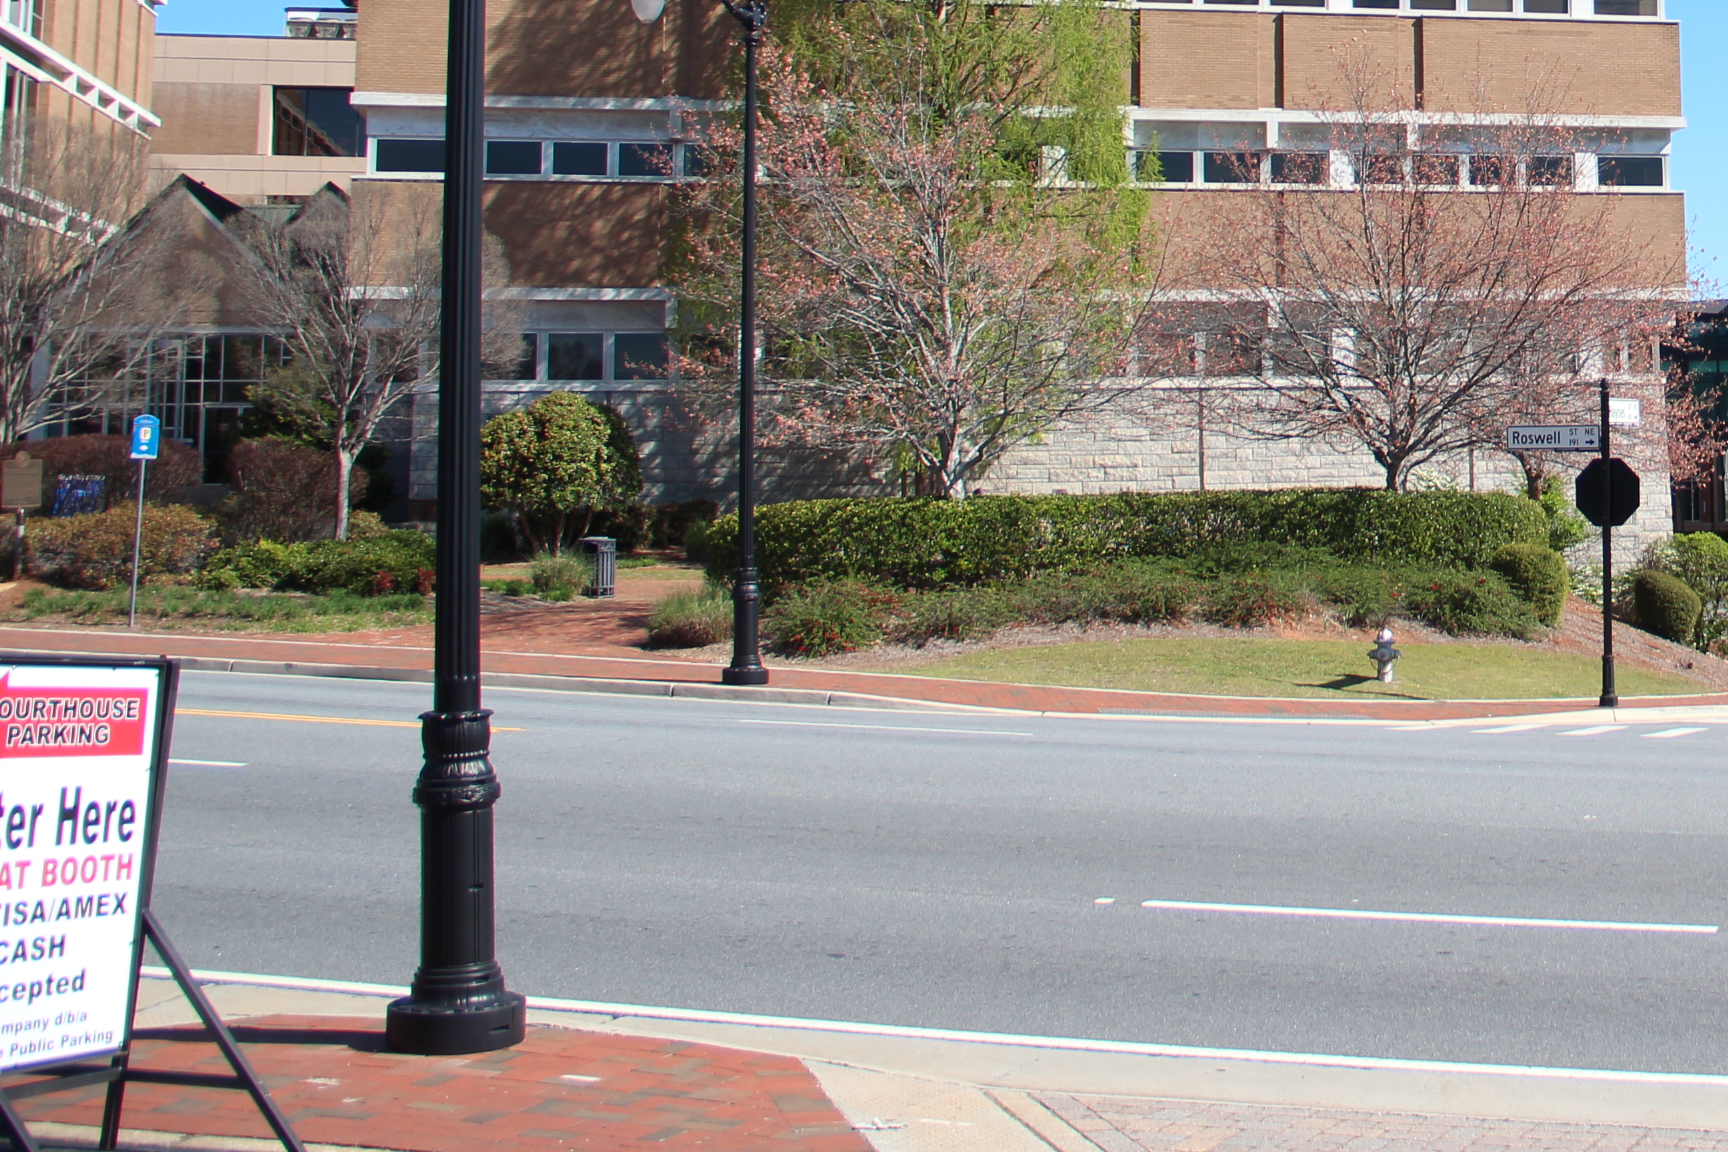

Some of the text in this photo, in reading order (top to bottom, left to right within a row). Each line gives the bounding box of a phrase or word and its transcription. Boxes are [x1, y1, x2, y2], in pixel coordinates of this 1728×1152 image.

[1512, 431, 1560, 445] Roswell
[1569, 428, 1578, 436] ST
[1569, 438, 1579, 446] 191
[6, 723, 111, 747] PARKING
[55, 785, 136, 846] Here
[0, 853, 133, 890] AT BOOTH
[0, 892, 128, 926] ISA/AMEX
[55, 1010, 87, 1026] d/b/a
[10, 1038, 55, 1057] Public
[61, 1030, 113, 1048] Parking
